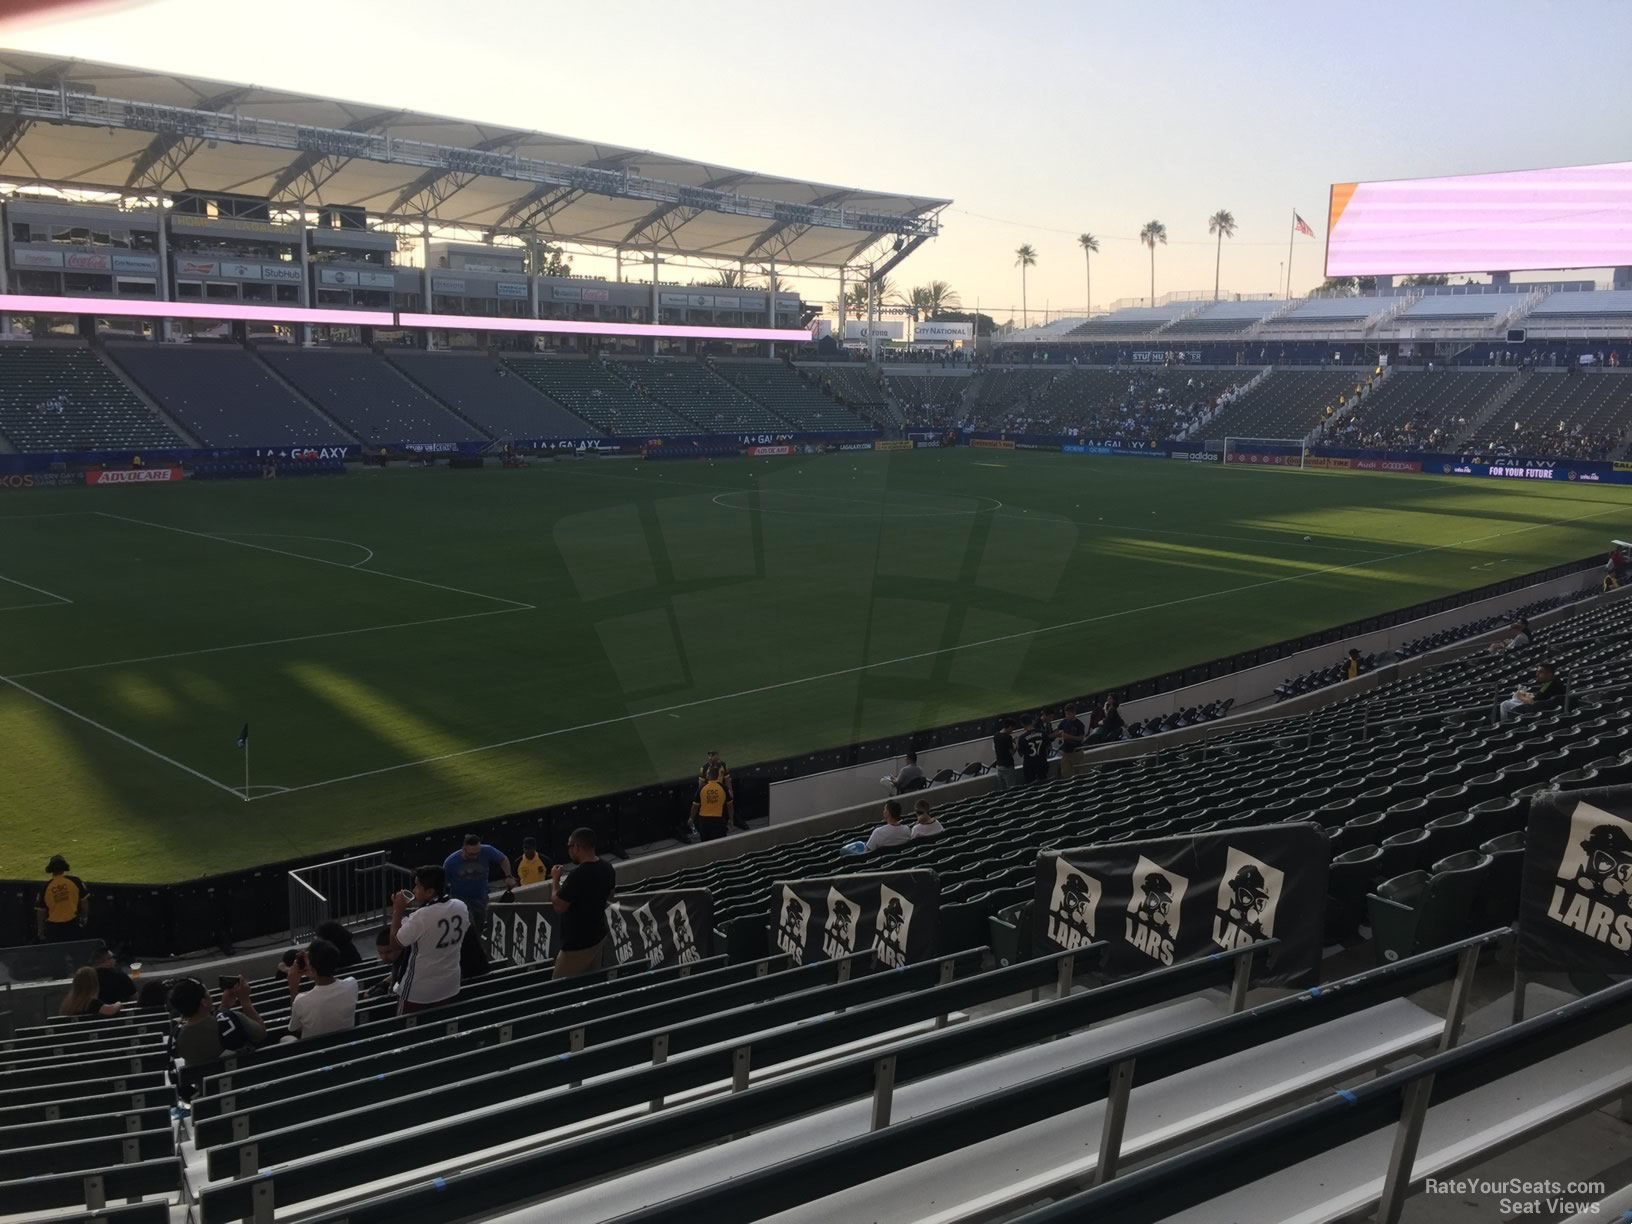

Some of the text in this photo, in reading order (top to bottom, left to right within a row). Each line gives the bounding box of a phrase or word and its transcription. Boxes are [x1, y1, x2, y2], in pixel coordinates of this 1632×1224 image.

[264, 268, 300, 279] StubHub
[860, 328, 889, 338] Crona
[930, 327, 966, 335] NATIONAL
[1189, 451, 1218, 461] adidas
[1357, 461, 1377, 469] Audi
[101, 470, 169, 482] ADVOCARE
[1489, 466, 1554, 479] FOR YOUR FUTURE
[1028, 740, 1043, 757] 37
[1547, 884, 1632, 951] LARS
[435, 915, 463, 949] 23
[1124, 916, 1175, 967] LARS
[615, 940, 634, 965] LARS
[871, 933, 906, 970] LARS
